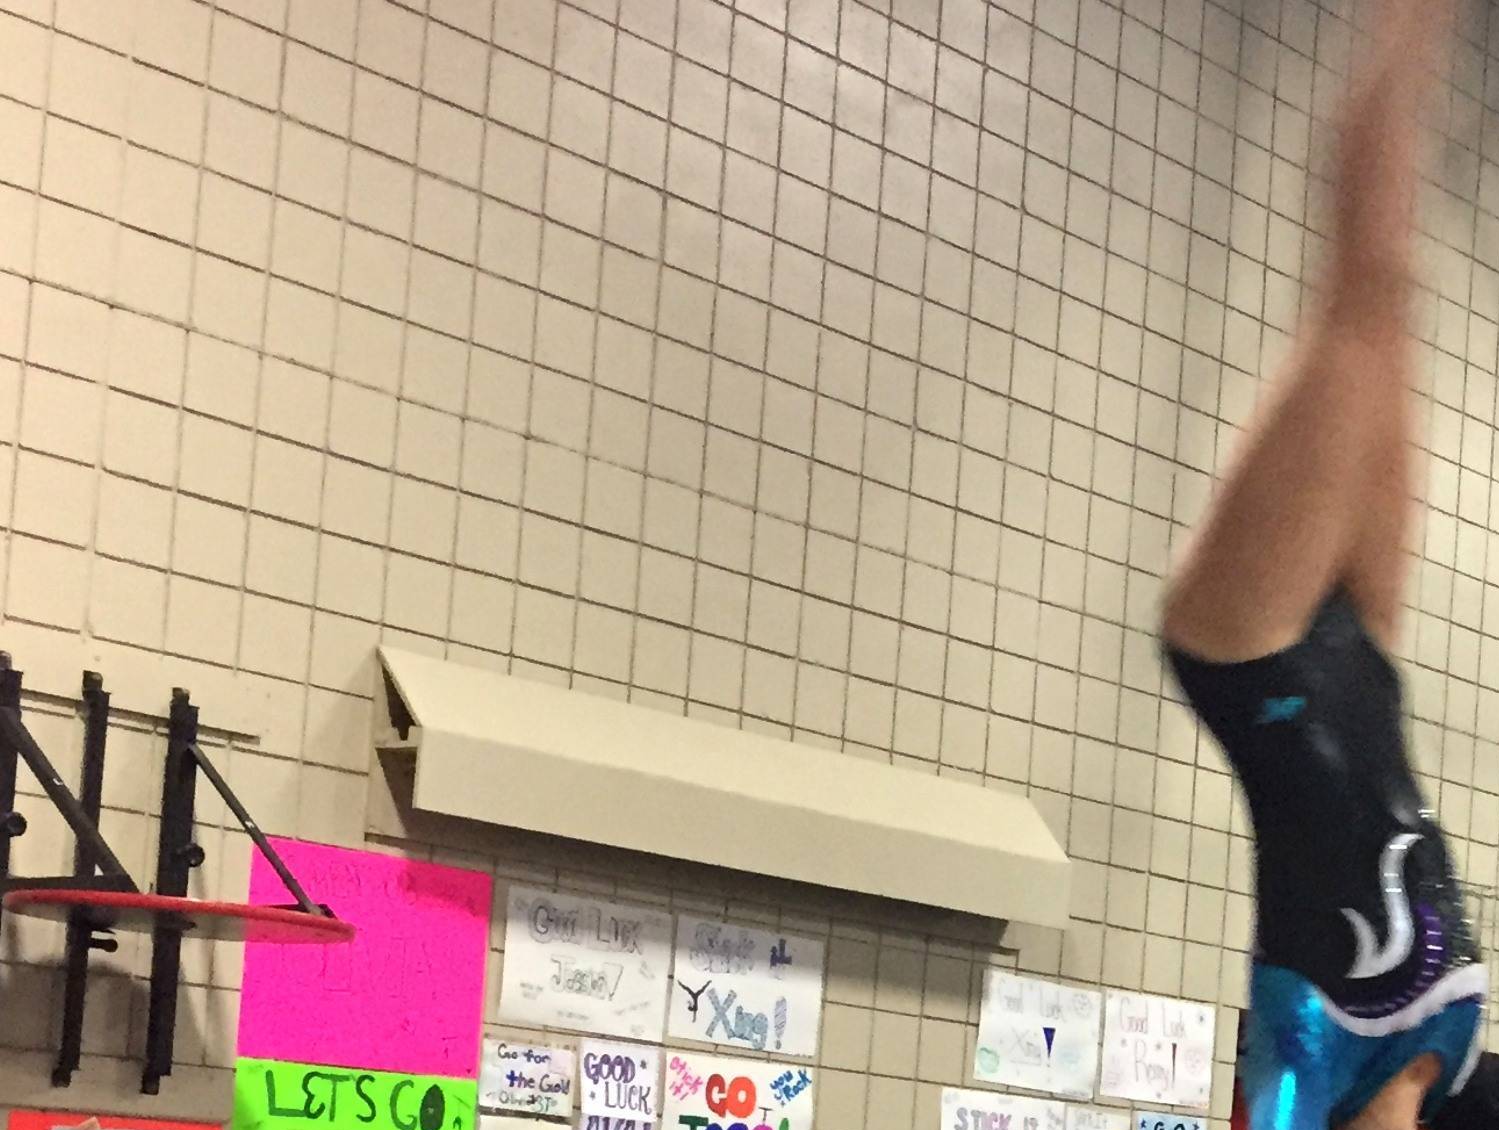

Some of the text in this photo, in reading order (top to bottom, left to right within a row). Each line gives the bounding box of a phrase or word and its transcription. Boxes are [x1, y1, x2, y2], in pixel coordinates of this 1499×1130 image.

[497, 1043, 552, 1065] Go for
[583, 1052, 636, 1084] GOOD
[506, 1070, 535, 1089] the
[705, 1073, 757, 1118] GO
[604, 1081, 652, 1114] LUCK
